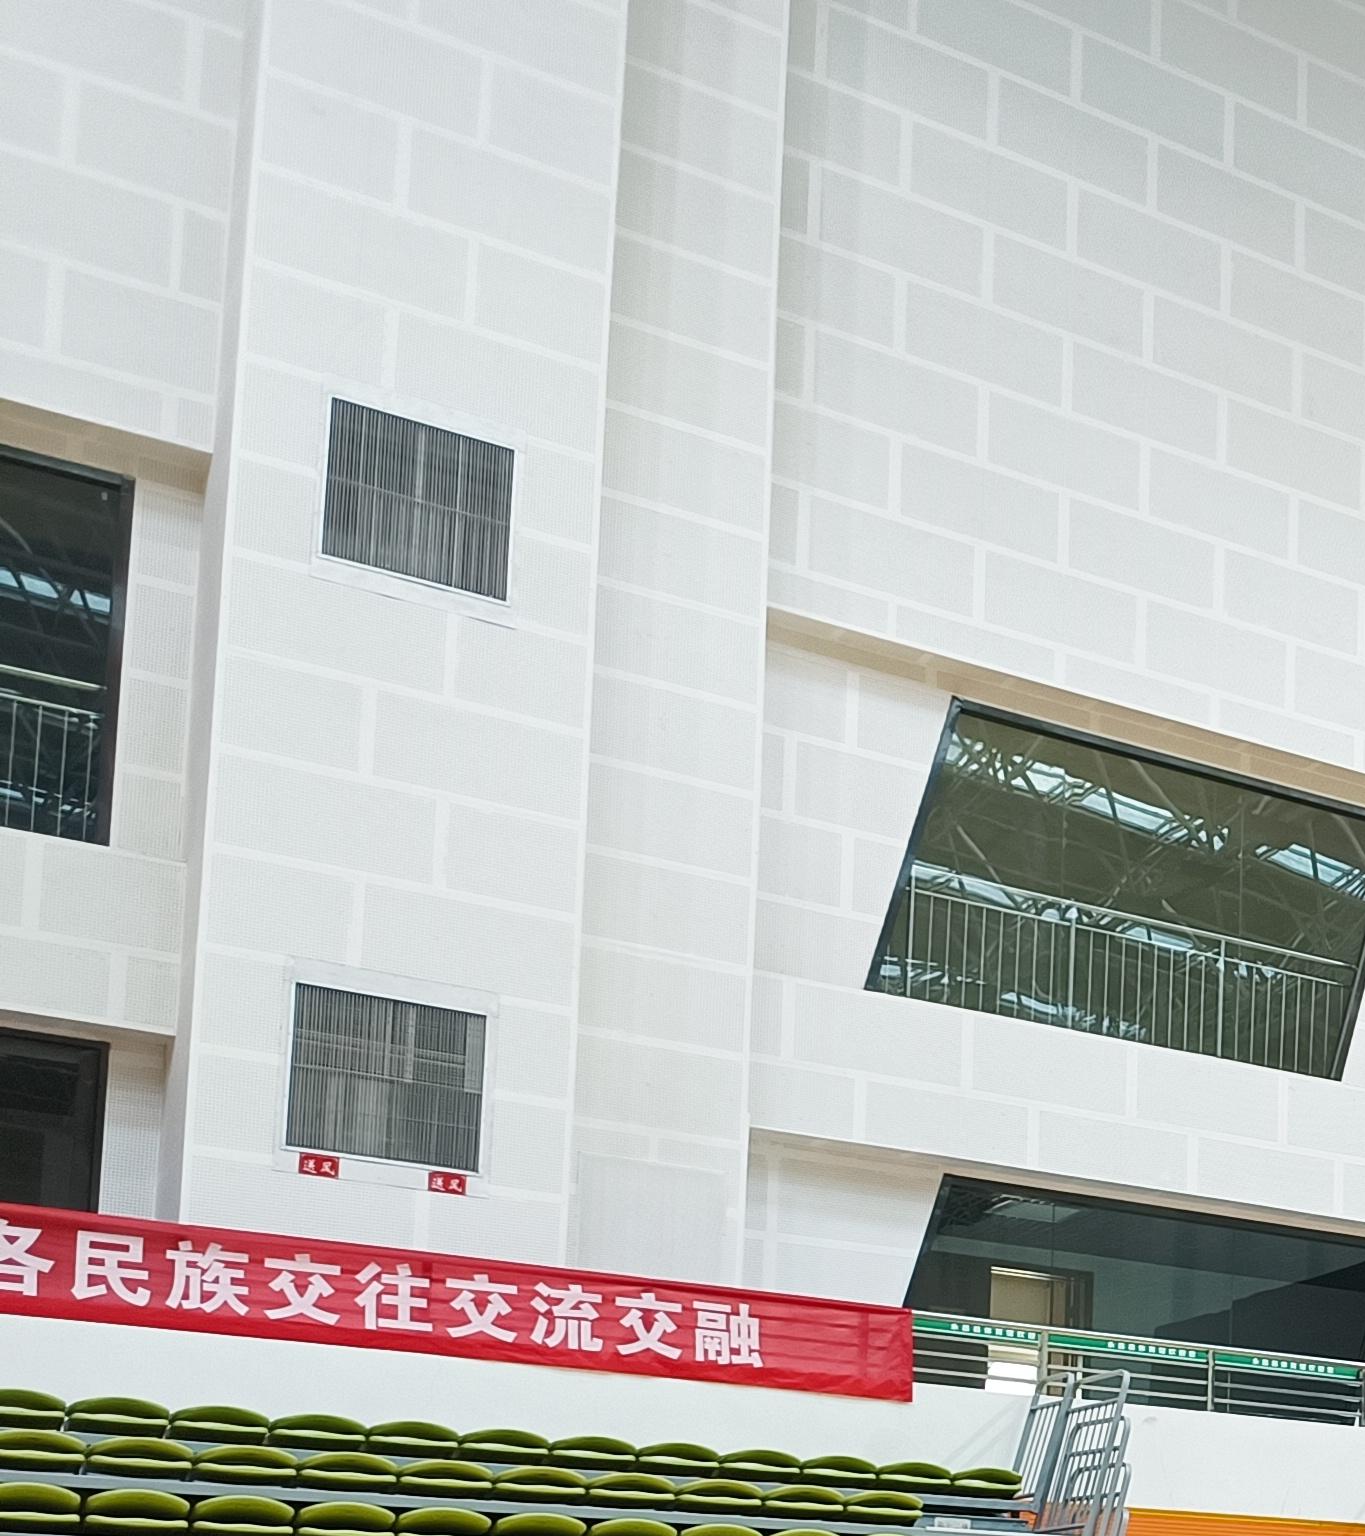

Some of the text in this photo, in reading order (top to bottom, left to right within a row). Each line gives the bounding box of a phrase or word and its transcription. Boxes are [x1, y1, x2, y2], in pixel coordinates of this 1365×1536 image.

[0, 1218, 764, 1368] 各民族交往交流交融
